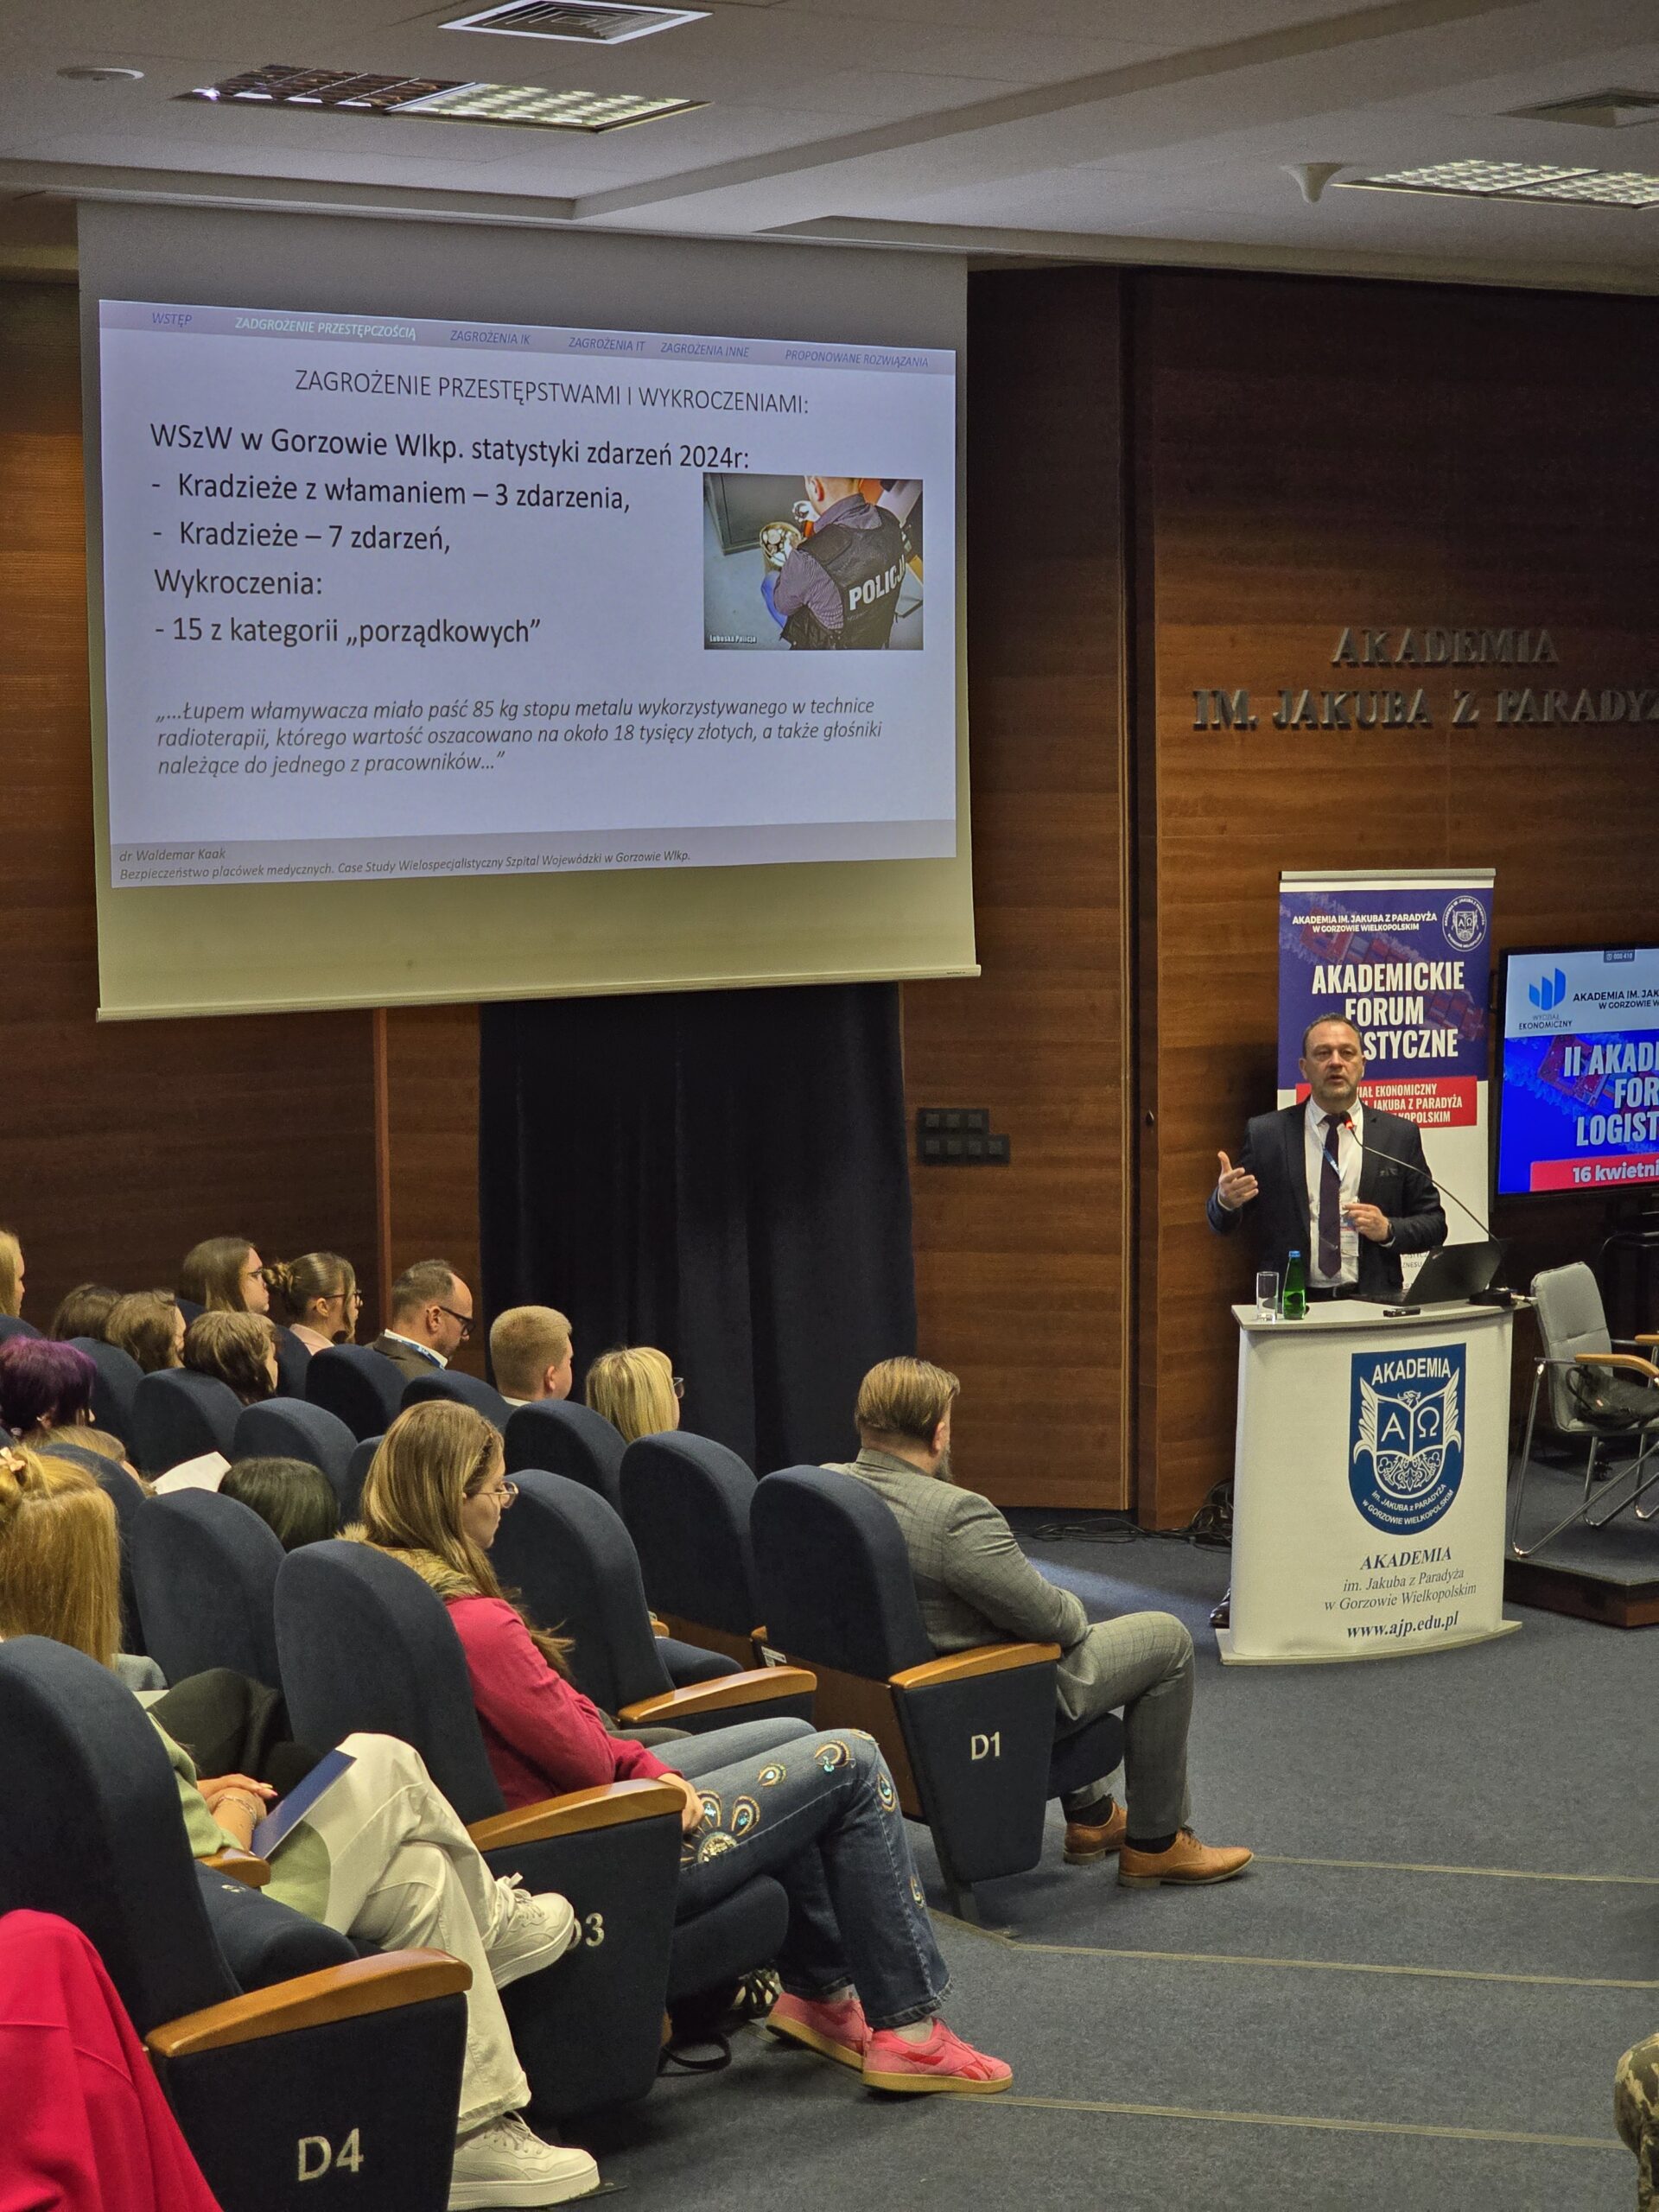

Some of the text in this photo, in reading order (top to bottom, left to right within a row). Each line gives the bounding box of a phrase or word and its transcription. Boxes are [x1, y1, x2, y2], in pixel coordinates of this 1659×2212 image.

[152, 312, 192, 327] WSTĘP
[235, 316, 416, 341] ZADGROŻENIE PRZESTĘPCZOŚCIĄ
[450, 329, 531, 344] ZAGROŻENIA IK
[569, 336, 645, 351] ZAGROŻENIA IT
[660, 341, 749, 358] ZAGROŻENIA INNE
[785, 349, 929, 369] PROPONOWANE ROZWIĄZANIA
[296, 368, 809, 415] ZAGROŻENIE PRZESTĘPSTWAMI I WYKROCZENIAMI:
[150, 423, 749, 469] WSzW w Gorzowie Wlkp. statystyki zdarzeń 2024r:
[179, 473, 297, 500] Kradzieże
[306, 481, 317, 500] z
[325, 477, 467, 505] włamaniem
[496, 484, 508, 506] 3
[517, 485, 630, 513] zdarzenia,
[180, 521, 298, 547] Kradzieże
[329, 525, 342, 548] 7
[351, 523, 451, 554] zdarzeń,
[154, 569, 322, 599] Wykroczenia:
[173, 617, 203, 641] 15
[211, 623, 222, 641] z
[230, 617, 339, 648] kategorii
[346, 617, 541, 649] „porządkowych”
[1332, 626, 1559, 668] AKADEMIA
[251, 700, 368, 723] włamywacza
[374, 698, 423, 721] miało
[428, 698, 468, 724] paść
[473, 700, 493, 719] 85
[499, 698, 518, 723] kg
[524, 701, 570, 721] stopu
[575, 698, 632, 716] metalu
[638, 697, 787, 720] wykorzystywanego
[792, 702, 806, 715] w
[810, 696, 874, 715] technice
[1193, 688, 1260, 730] IM.
[1273, 688, 1433, 729] JAKUBA
[1452, 688, 1480, 728] Z
[157, 720, 882, 750] radioterapii, którego wartość oszacowano na około 18 tysięcy złotych, a także głośniki
[158, 753, 239, 779] należące
[245, 753, 267, 774] do
[270, 753, 346, 779] jednego
[350, 758, 359, 773] z
[119, 848, 226, 862] dr Waldemar Kaak
[120, 849, 691, 882] Bezpieczeństwo placówek medycznych. Case Study Wielospecjalistyczny Szpital Wojewódzki w Gorzowie Wlkp.
[1293, 915, 1337, 925] AKADEMIA
[1338, 914, 1350, 924] IM.
[1351, 913, 1383, 924] JAKUBA
[1392, 911, 1438, 922] PARADYŻA
[1313, 923, 1420, 933] W GORZOWIE WIELKOPOLSKIM
[1312, 961, 1465, 995] AKADEMICKIE
[1573, 991, 1624, 1002] AKADEMIA
[1626, 990, 1640, 1000] IM.
[1599, 1001, 1606, 1009] W
[1608, 999, 1651, 1009] GORZOWIE
[1345, 996, 1424, 1027] FORUM
[1519, 1020, 1573, 1030] EKONOMICZNY
[1360, 1028, 1459, 1061] STYCZNE
[1564, 1046, 1581, 1077] II
[1376, 1084, 1438, 1097] EKONOMICZNY
[1408, 1098, 1414, 1109] Z
[1415, 1094, 1463, 1110] PARADYŻA
[1573, 1166, 1592, 1184] 16
[1371, 1357, 1452, 1386] AKADEMIA
[1381, 1412, 1406, 1442] A
[1367, 1504, 1403, 1524] GORZOWIE
[1403, 1489, 1454, 1525] WIELKOPOLSKIM
[1371, 1490, 1380, 1502] im.
[1381, 1498, 1408, 1511] JAKUBA
[1414, 1484, 1446, 1510] PARADYŻA
[1360, 1546, 1452, 1571] AKADEMIA
[1343, 1567, 1465, 1592] im. Jakuba z Paradyża
[1324, 1583, 1477, 1612] w Gorzowie Wielkopolskim
[1347, 1611, 1459, 1639] www.ajp.edu.pl
[970, 1732, 1001, 1761] D1
[297, 2127, 365, 2182] D4
